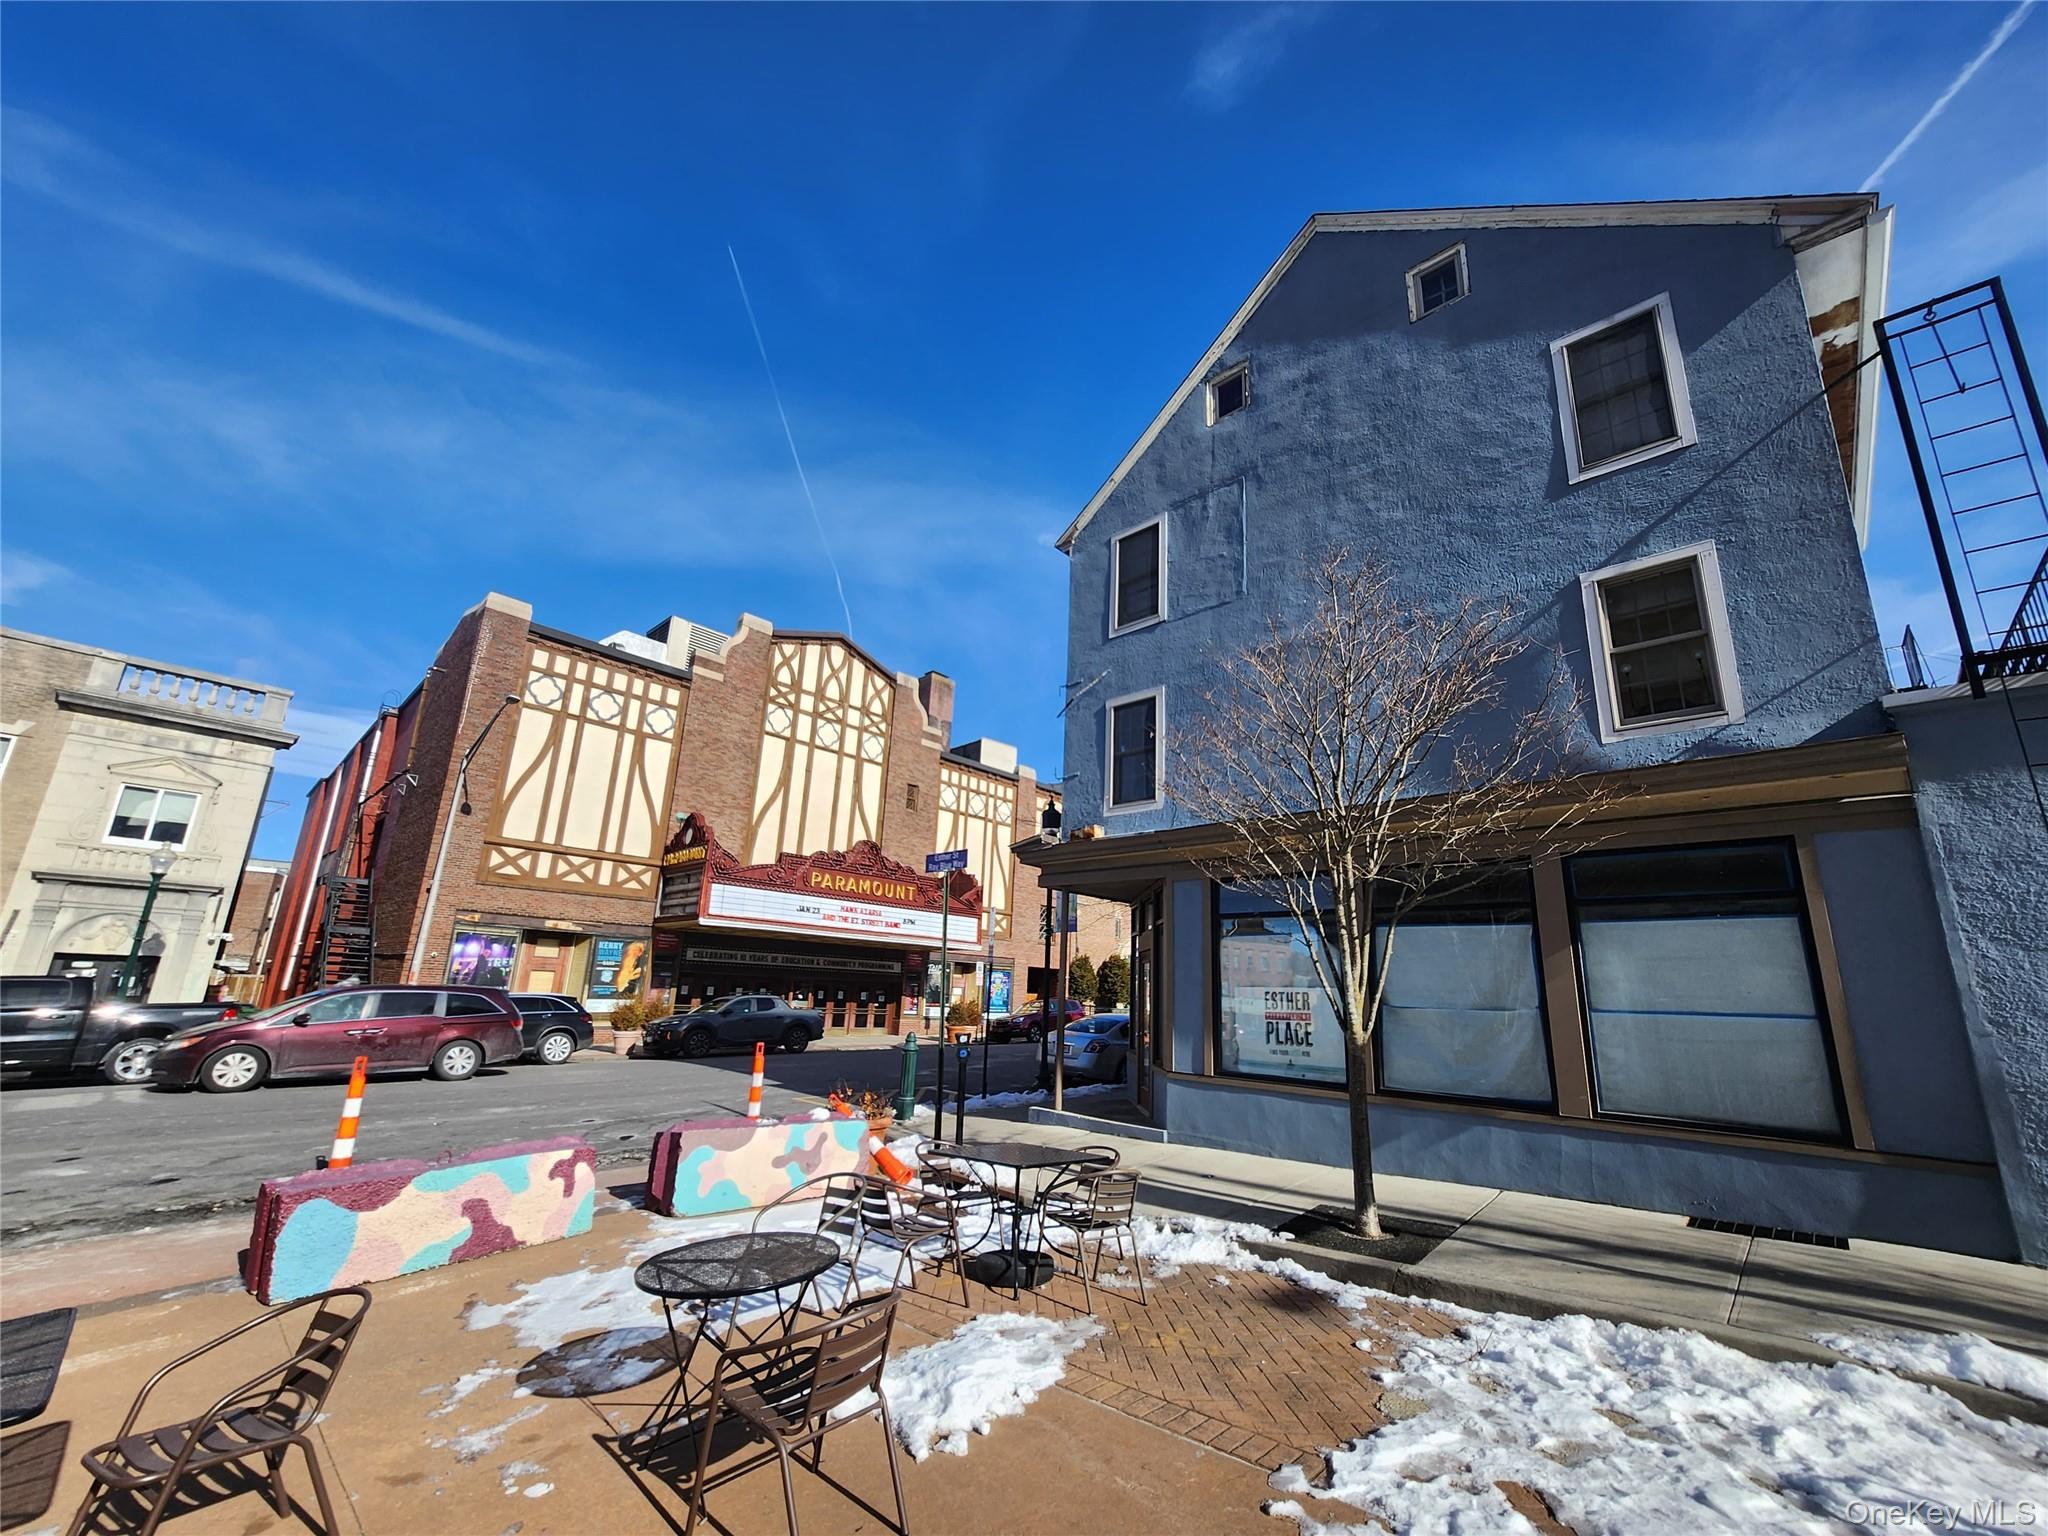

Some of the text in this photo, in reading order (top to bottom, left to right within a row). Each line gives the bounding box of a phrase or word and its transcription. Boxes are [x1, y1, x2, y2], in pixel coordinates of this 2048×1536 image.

[811, 871, 917, 901] PARAMOUNT
[796, 905, 811, 913] JAN
[1264, 991, 1311, 1011] ESTHER
[1265, 1021, 1314, 1048] PLACE
